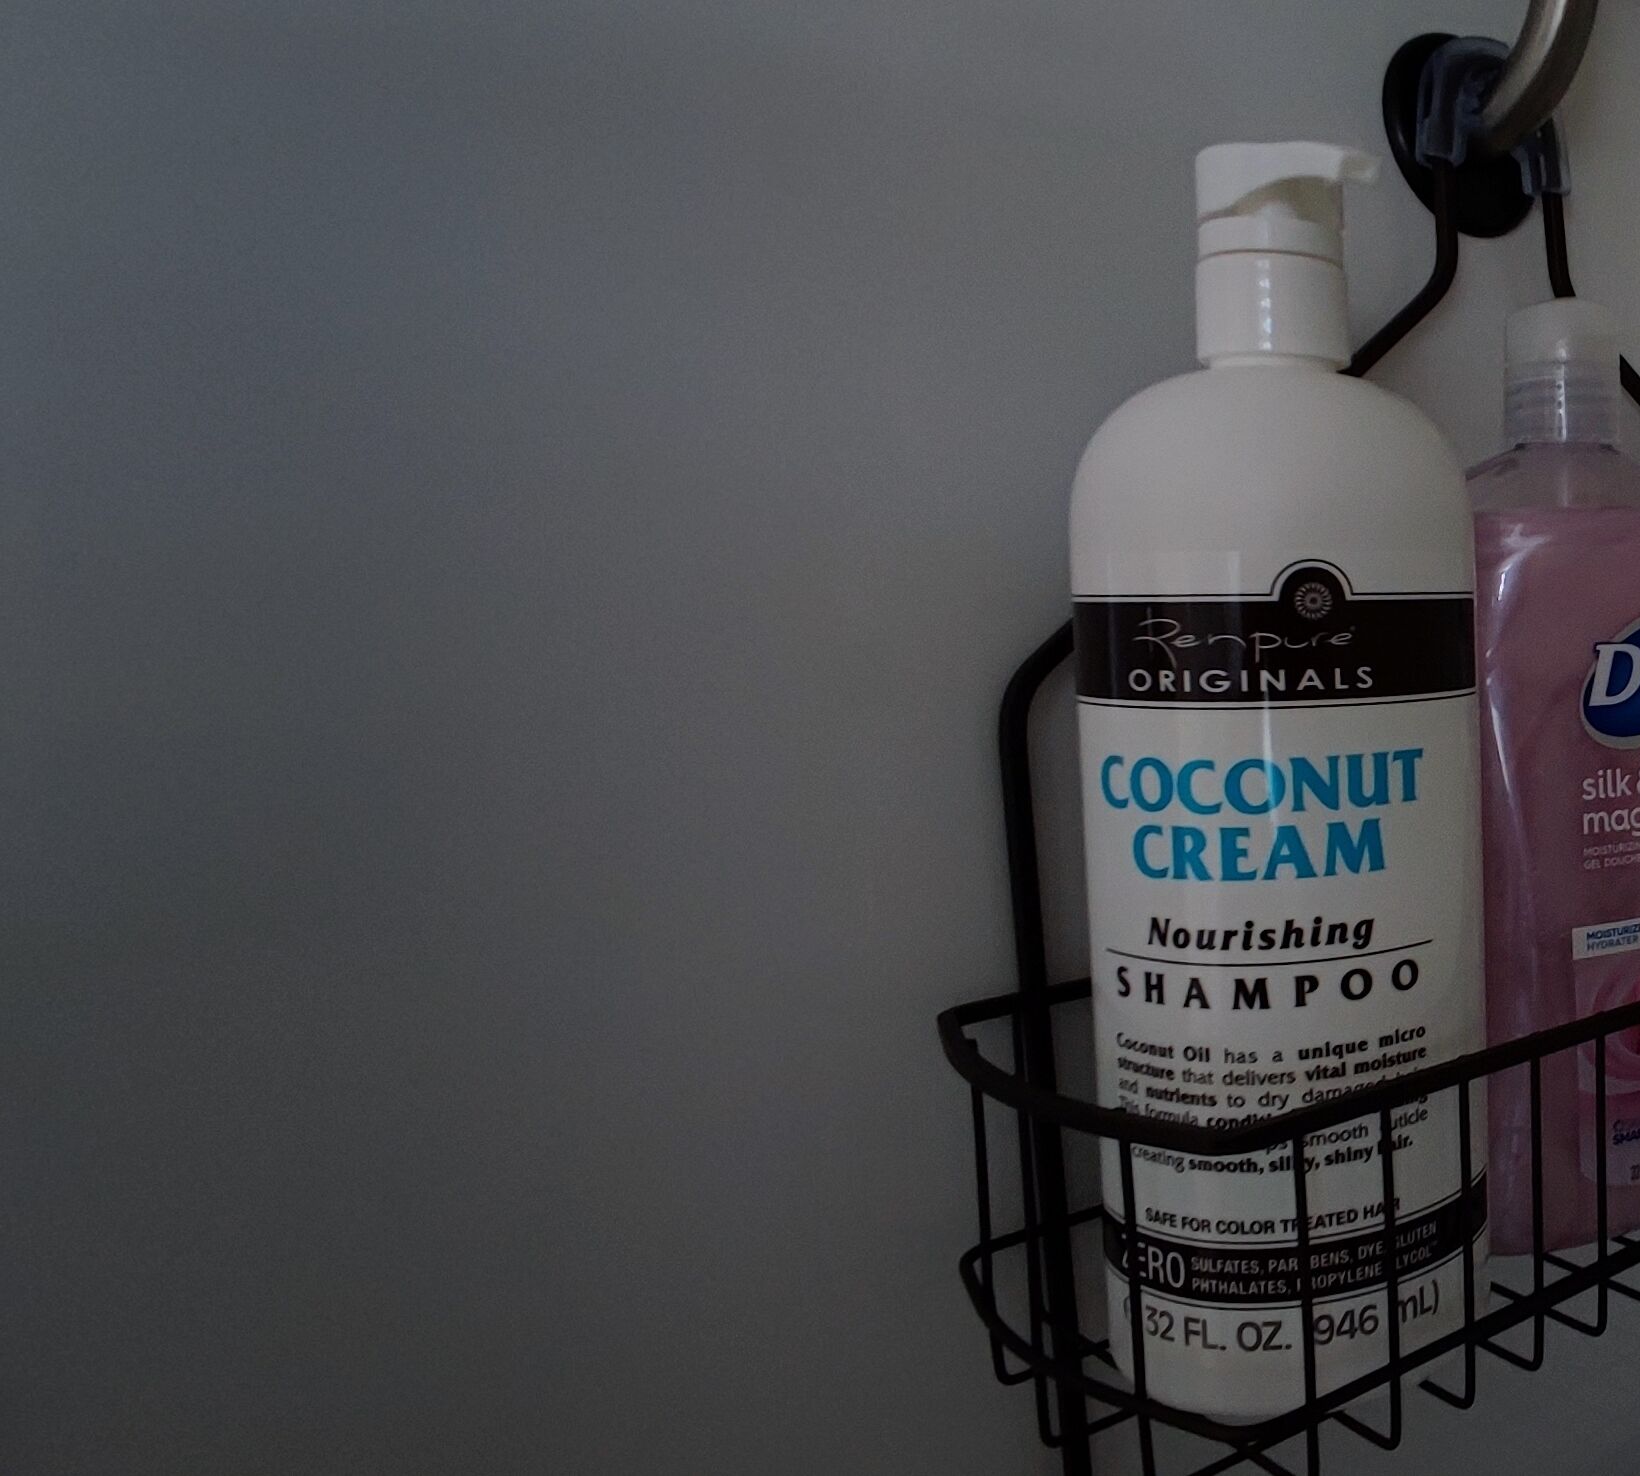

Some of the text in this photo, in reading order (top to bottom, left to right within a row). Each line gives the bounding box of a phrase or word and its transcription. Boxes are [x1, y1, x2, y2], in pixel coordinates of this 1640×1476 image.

[1128, 665, 1374, 693] ORIGINALS
[1101, 747, 1425, 816] COCONUT
[1582, 766, 1633, 801] silk
[1132, 817, 1387, 882] CREAM
[1148, 916, 1375, 950] Nourishing
[1116, 958, 1420, 1011] SHAMPOO
[1116, 1025, 1427, 1064] Coconut Oil has a unique micro
[1116, 1046, 1428, 1086] structure that delivers vital moisture
[1145, 1086, 1218, 1107] nutrients
[1226, 1092, 1247, 1108] to
[1257, 1090, 1291, 1111] dry
[1388, 1107, 1429, 1132] uticle
[1188, 1157, 1265, 1175] smooth,
[1268, 1153, 1321, 1174] sily,
[1324, 1144, 1374, 1166] shiny
[1145, 1207, 1178, 1228] SAFE
[1181, 1215, 1211, 1233] FOR
[1215, 1219, 1276, 1236] COLOR
[1190, 1255, 1265, 1276] SULFATES,
[1268, 1249, 1354, 1274] PARBENS,
[1191, 1245, 1433, 1298] PHTHALATES, OPYLENE LYCOL
[1144, 1304, 1176, 1342] 32
[1183, 1316, 1227, 1351] FL.
[1236, 1320, 1292, 1352] OZ.
